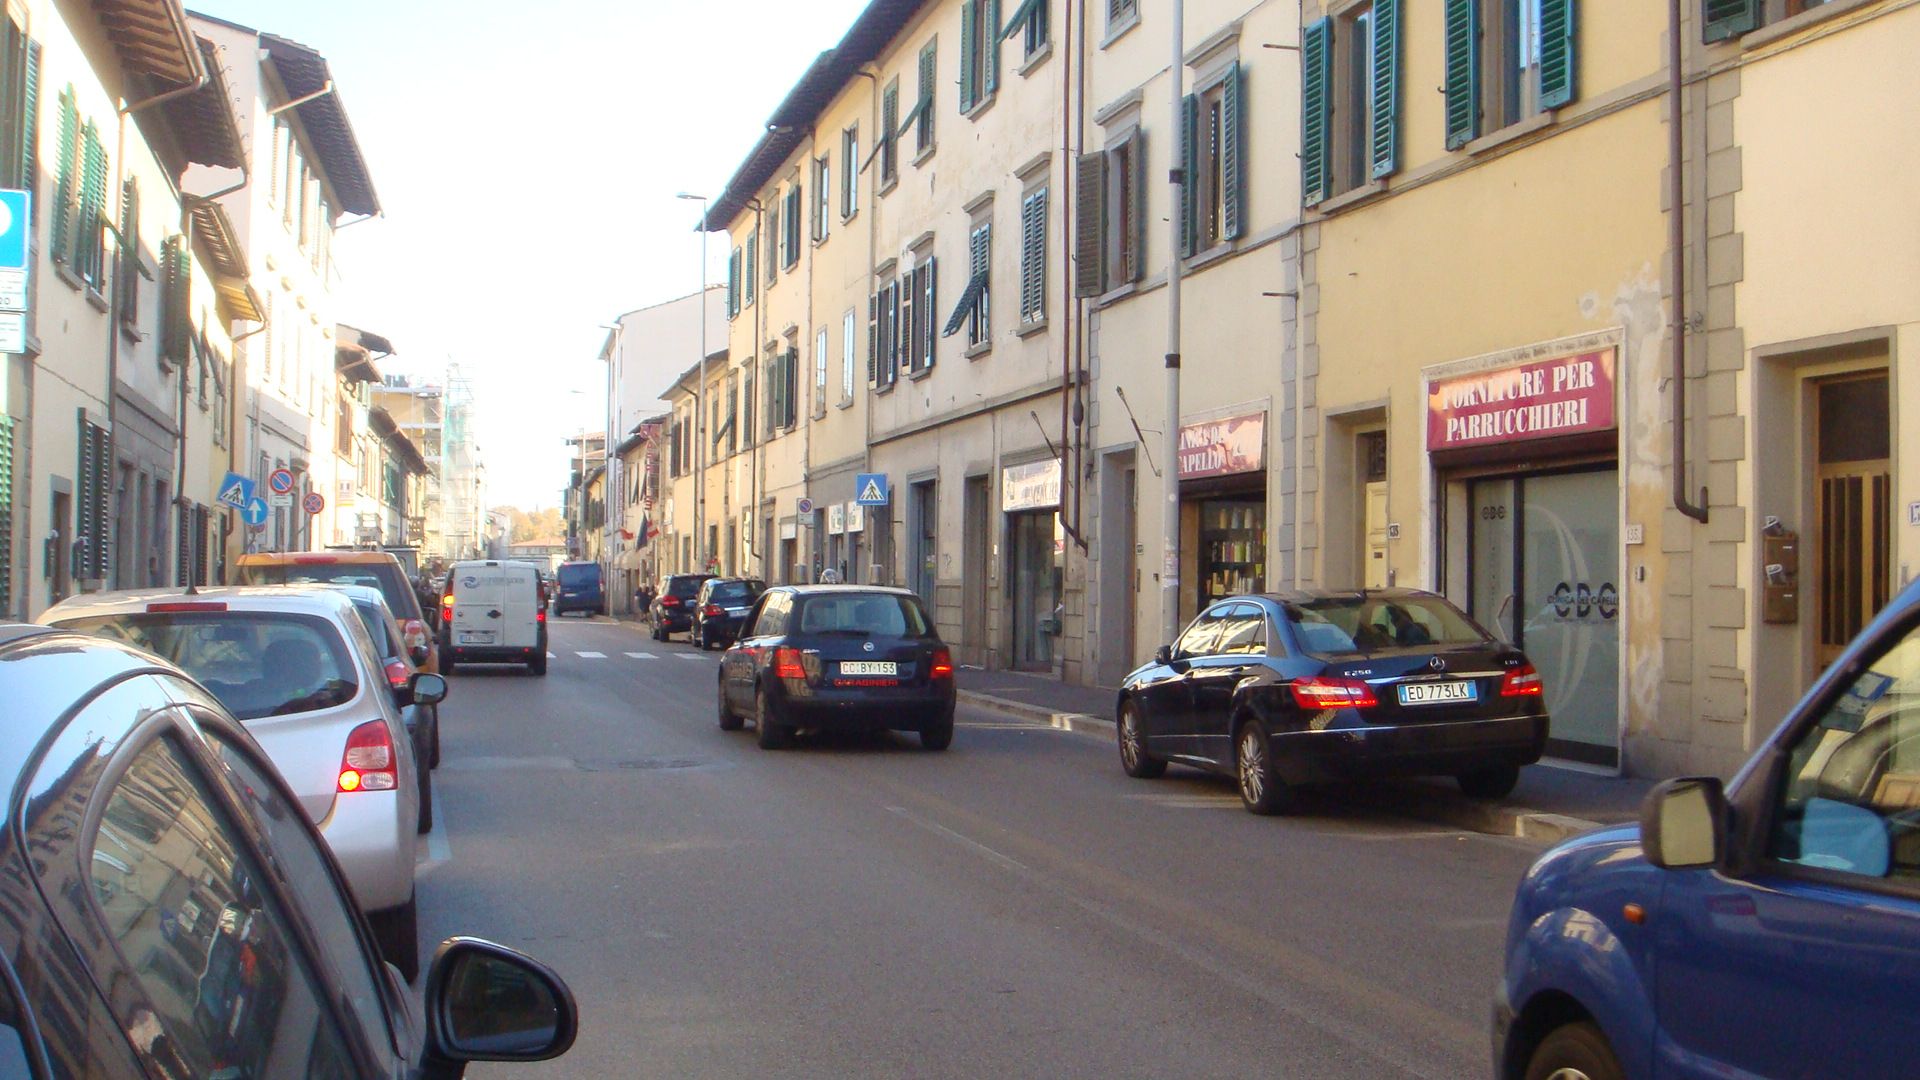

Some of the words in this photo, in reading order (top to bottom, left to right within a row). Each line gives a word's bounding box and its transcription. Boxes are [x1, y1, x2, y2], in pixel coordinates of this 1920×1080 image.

[1442, 369, 1544, 410] FORNITURE
[1552, 361, 1595, 392] PER
[1445, 398, 1589, 442] PARRUCCHIERI
[1428, 681, 1468, 699] 773LK
